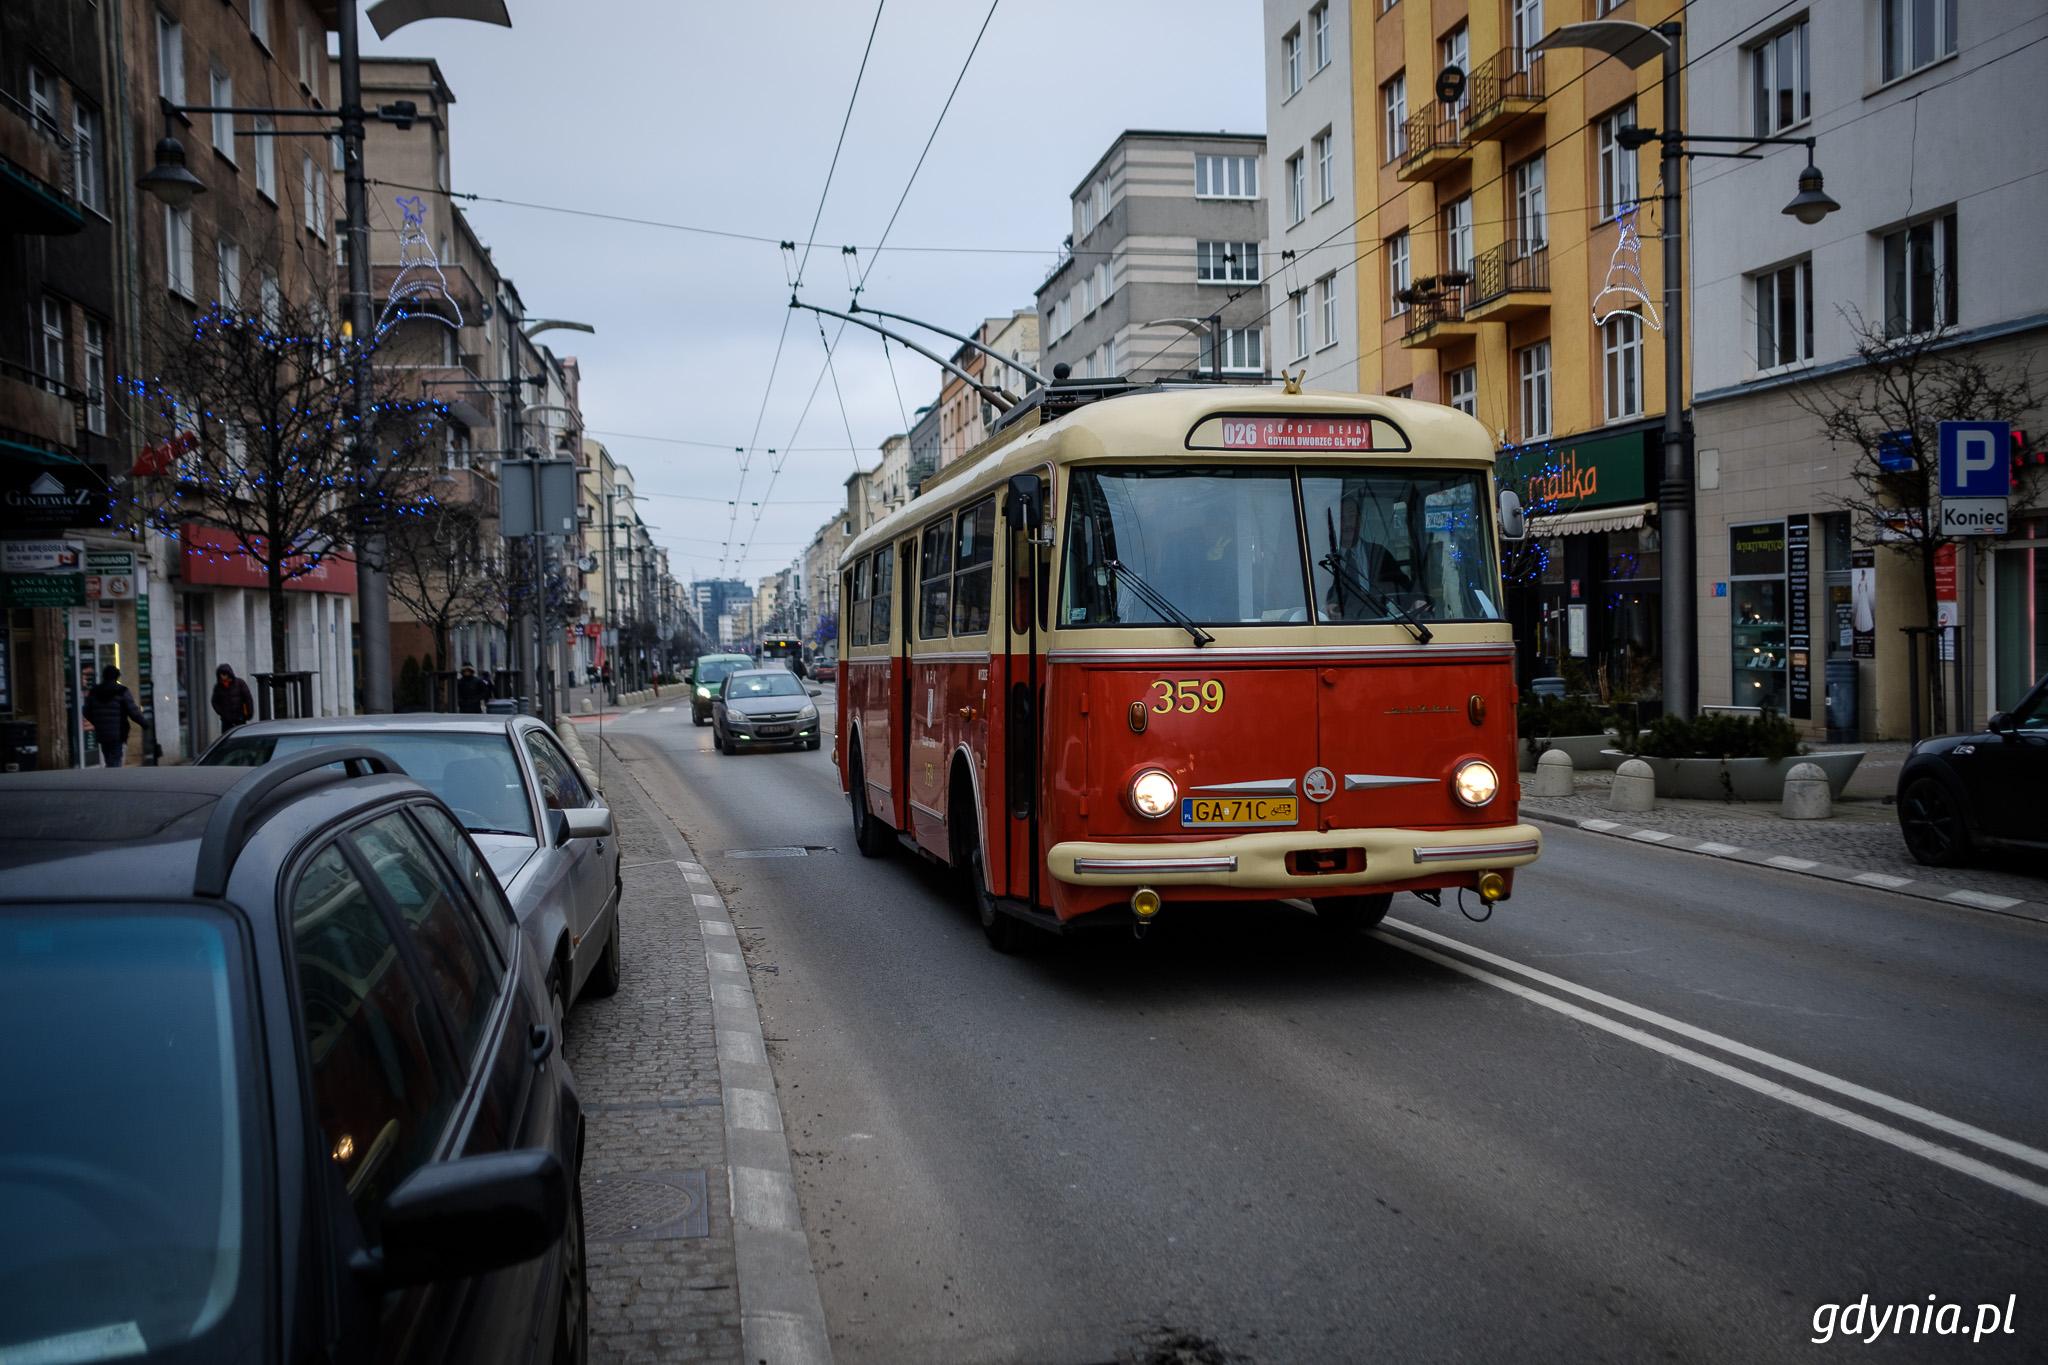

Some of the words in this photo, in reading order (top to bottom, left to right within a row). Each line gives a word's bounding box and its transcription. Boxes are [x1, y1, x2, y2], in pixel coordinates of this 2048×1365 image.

[1224, 423, 1257, 445] 026
[1267, 423, 1312, 434] SOPOT
[1328, 424, 1361, 435] REJA
[1267, 436, 1296, 446] GDYNIA
[1297, 436, 1332, 447] DWORZEC
[1346, 437, 1362, 447] PKP
[1956, 429, 1995, 488] P
[1528, 448, 1598, 503] malika
[1945, 508, 2004, 526] Koniec
[87, 556, 129, 564] OMBARD
[1151, 679, 1225, 714] 359
[1196, 801, 1224, 821] GA
[1231, 801, 1267, 820] 71C
